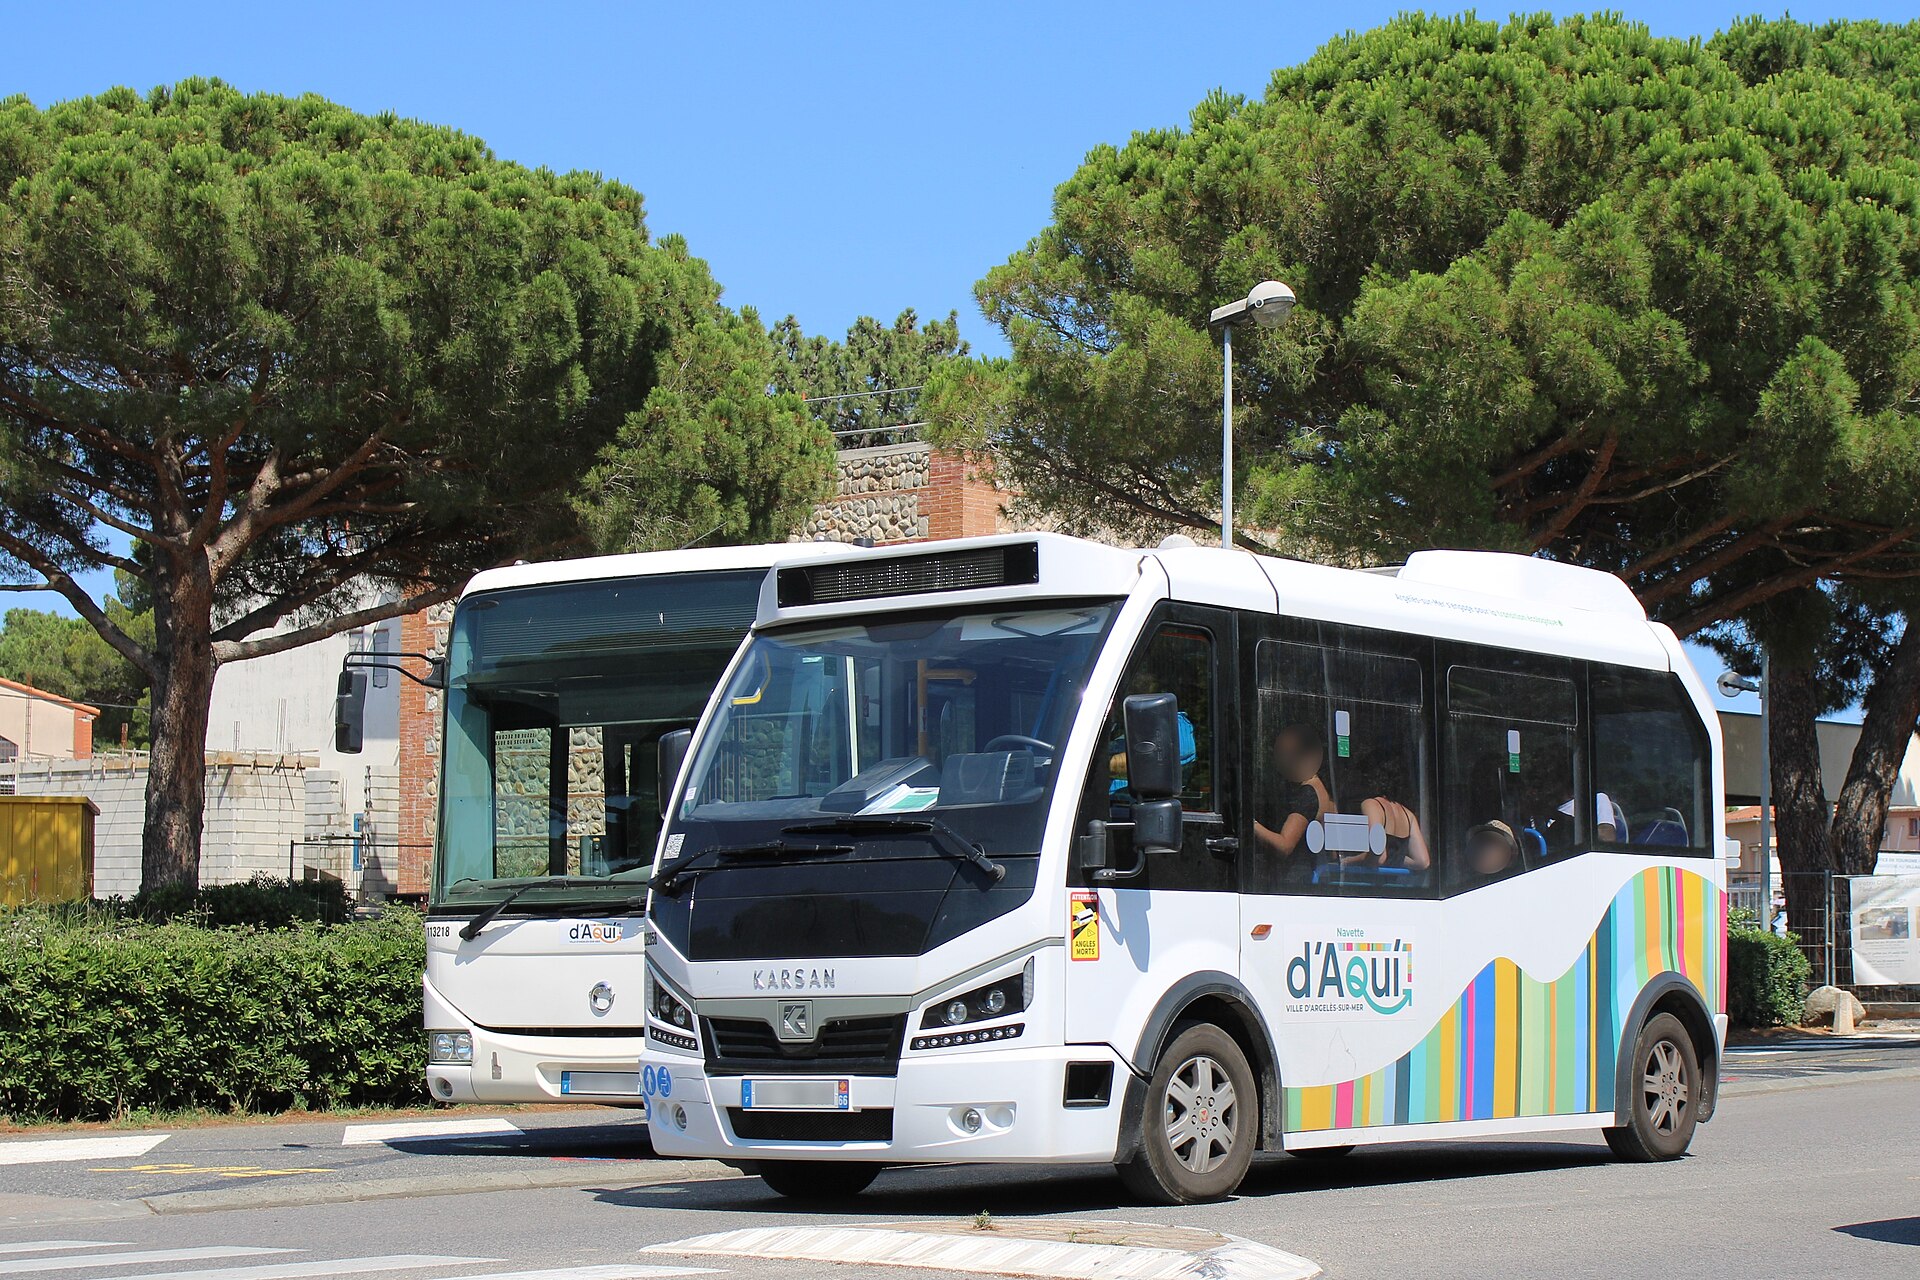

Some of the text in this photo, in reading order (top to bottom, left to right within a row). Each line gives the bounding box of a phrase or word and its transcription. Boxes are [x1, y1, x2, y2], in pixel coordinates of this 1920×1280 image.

[427, 926, 450, 938] 113218
[1336, 927, 1364, 938] Navette
[753, 968, 835, 990] KARSAN
[1286, 1004, 1304, 1013] VILLE
[838, 1095, 848, 1106] 66
